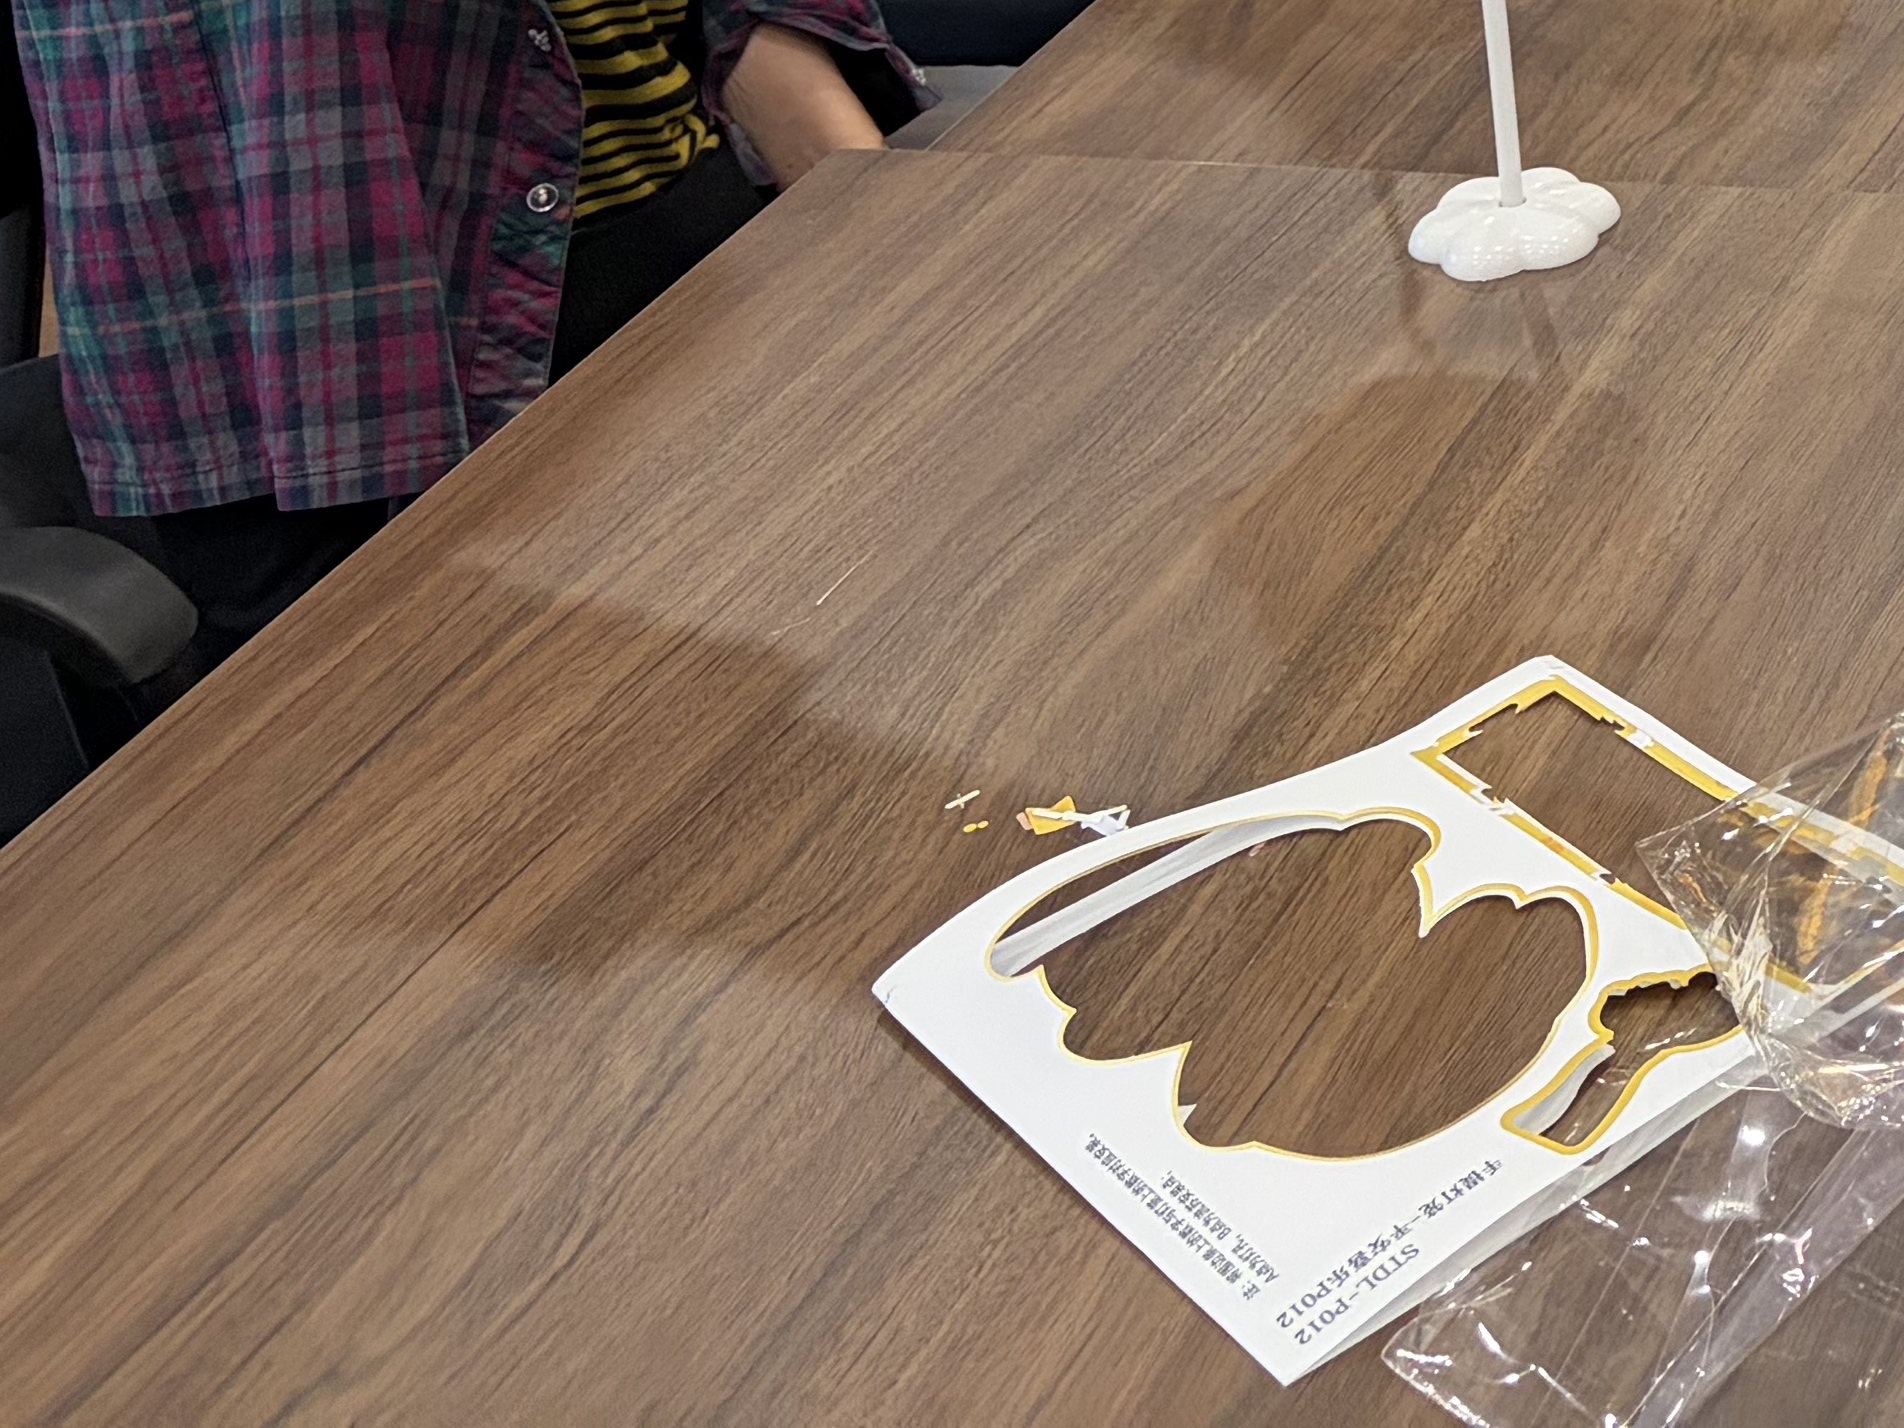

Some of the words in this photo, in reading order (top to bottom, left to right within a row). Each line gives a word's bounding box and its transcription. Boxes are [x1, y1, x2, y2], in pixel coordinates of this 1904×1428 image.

[1276, 1159, 1503, 1329] 手提灯笼-平安喜乐P012
[1294, 1243, 1420, 1345] STDL-P012
